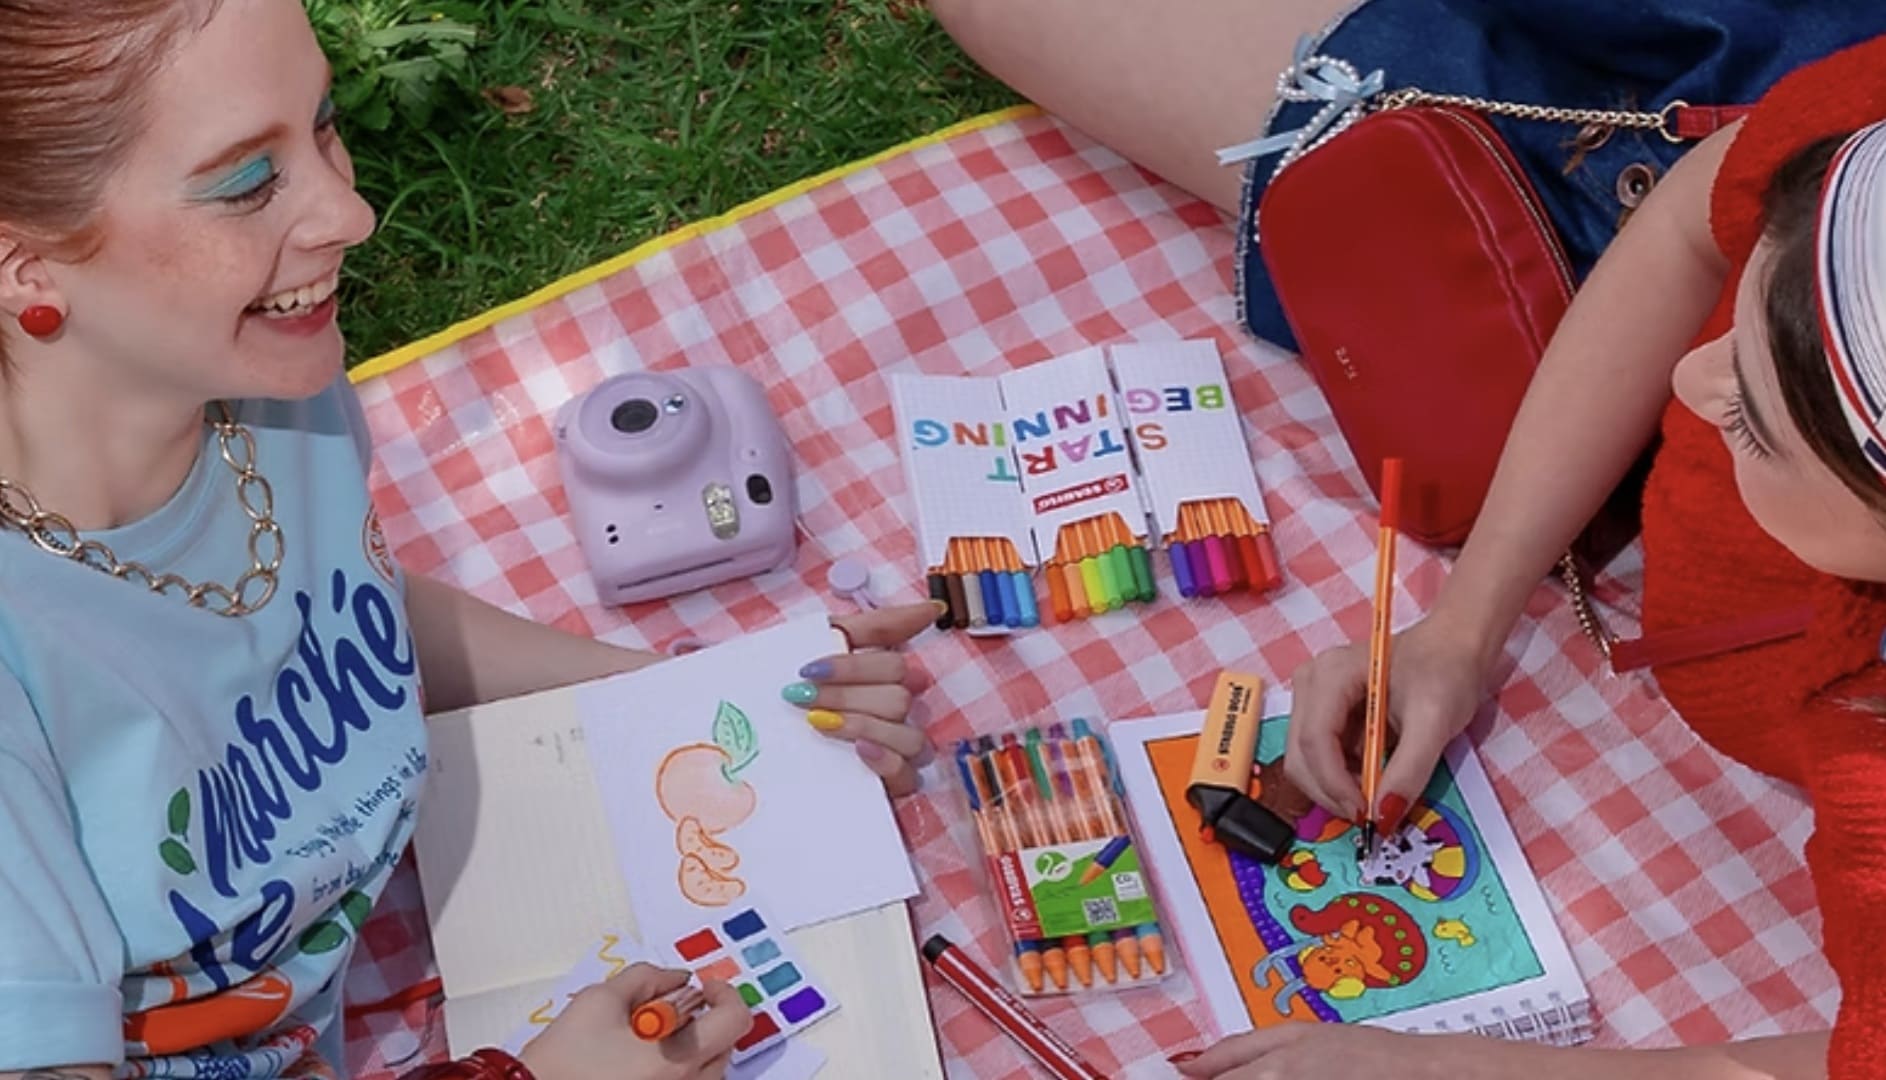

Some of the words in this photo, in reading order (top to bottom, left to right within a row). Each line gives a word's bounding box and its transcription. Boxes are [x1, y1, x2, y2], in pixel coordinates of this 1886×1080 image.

[913, 384, 1225, 447] BEGINNING
[986, 423, 1168, 483] START
[1037, 483, 1104, 511] STABILO
[354, 776, 402, 816] things
